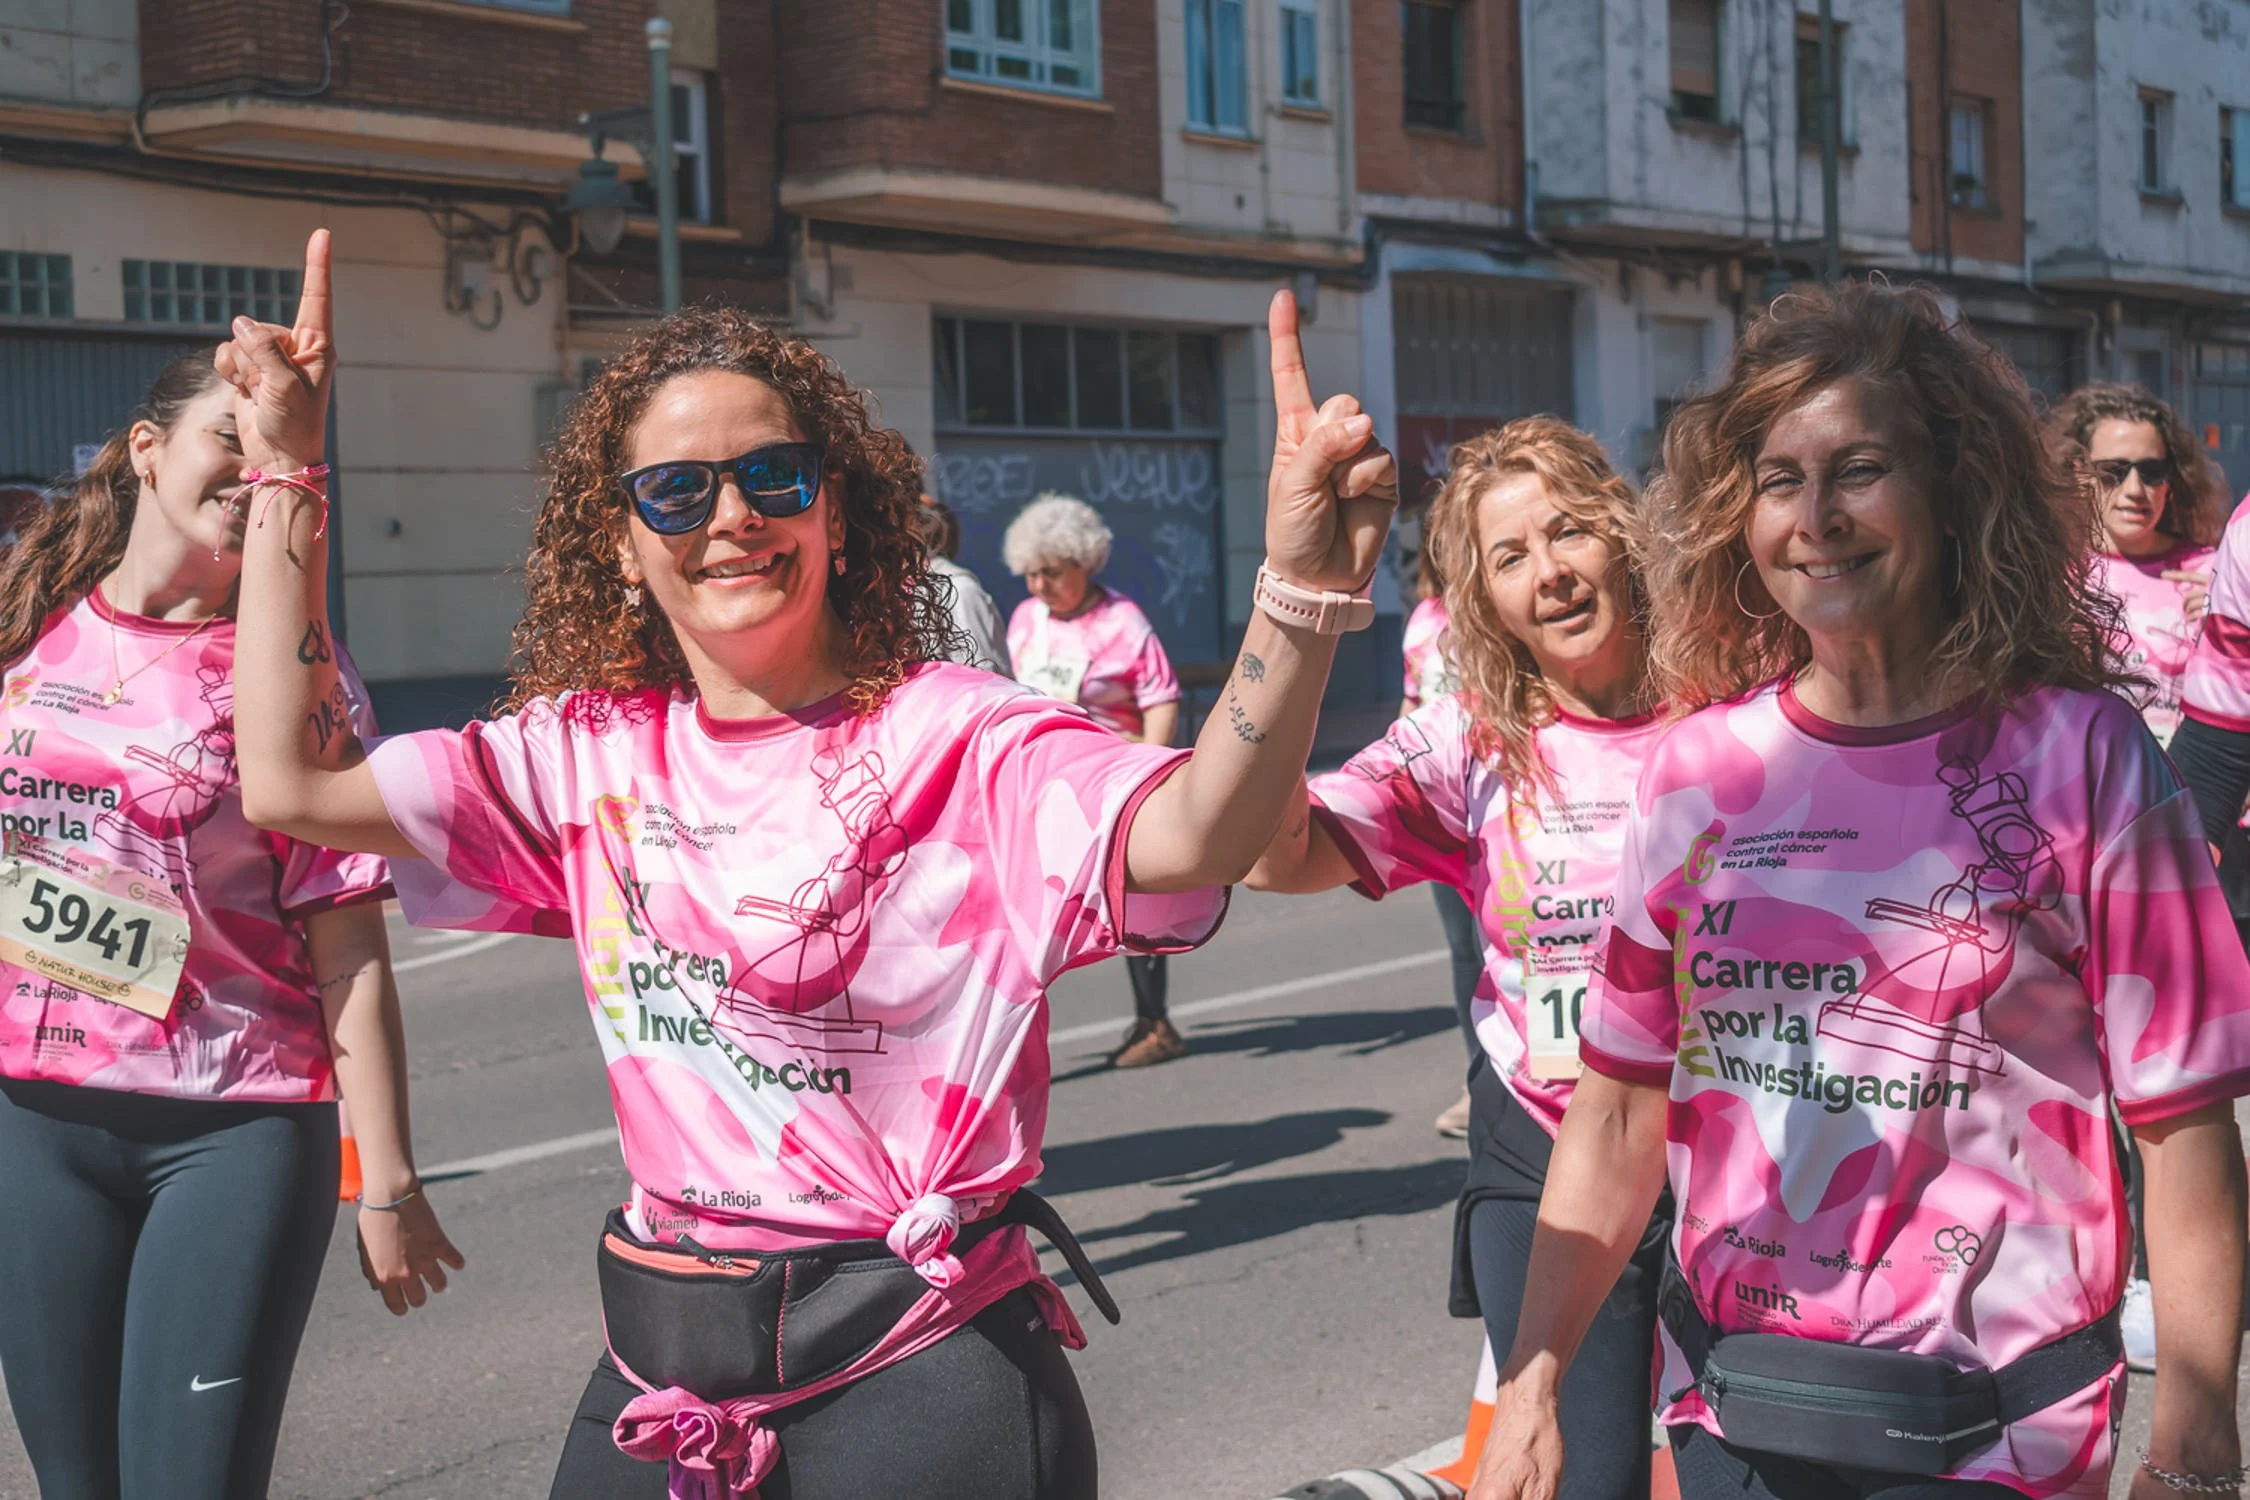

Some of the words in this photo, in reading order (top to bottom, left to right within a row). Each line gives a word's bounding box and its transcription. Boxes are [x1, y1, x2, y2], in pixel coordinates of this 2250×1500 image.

[43, 699, 55, 708] La
[56, 701, 80, 714] Rioja
[4, 729, 37, 757] XI
[0, 767, 117, 811] Carrera
[1, 813, 51, 838] por
[59, 811, 88, 842] la
[1732, 830, 1794, 846] asociación
[1797, 828, 1859, 841] española
[641, 836, 654, 846] en
[1726, 846, 1766, 858] contra
[1767, 843, 1779, 854] el
[1781, 843, 1828, 853] cáncer
[1534, 860, 1566, 885] XI
[1720, 861, 1737, 870] en
[1738, 859, 1753, 870] La
[1755, 857, 1788, 870] Rioja
[22, 878, 152, 968] 5941
[1694, 900, 1736, 936] XI
[626, 906, 728, 988] Crrera
[1690, 950, 1858, 994] Carrera
[34, 986, 47, 998] La
[48, 987, 79, 1003] Rioja
[1700, 1008, 1766, 1042] por
[1774, 1003, 1808, 1045] la
[1714, 1045, 1970, 1114] Investigación
[701, 1191, 718, 1207] La
[721, 1190, 761, 1210] Rioja
[657, 1215, 698, 1231] viamed
[1748, 1235, 1786, 1258] Rioja
